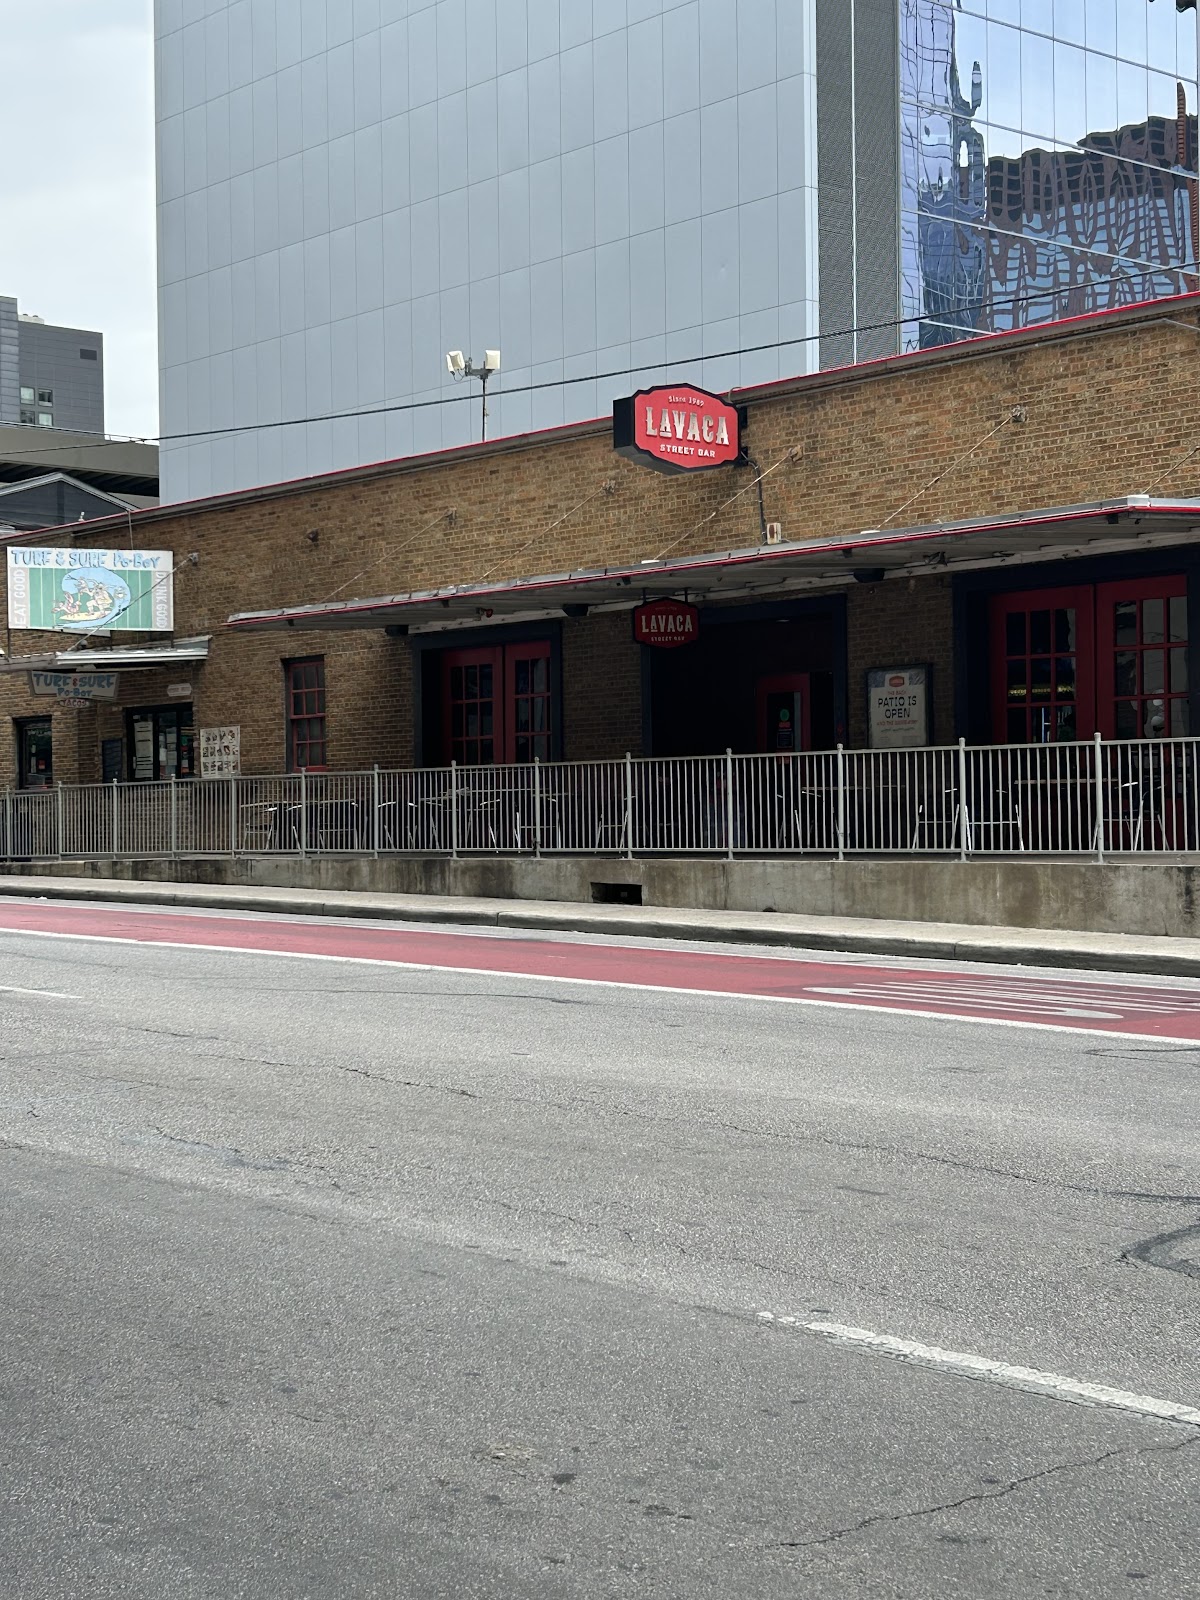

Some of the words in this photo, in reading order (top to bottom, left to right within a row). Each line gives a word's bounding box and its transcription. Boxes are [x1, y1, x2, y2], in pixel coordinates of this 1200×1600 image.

[646, 407, 730, 445] LAVACA
[660, 444, 694, 455] STREET
[698, 448, 715, 458] BAR
[11, 550, 51, 565] TURF
[56, 551, 65, 567] &
[69, 551, 107, 567] SURF
[13, 569, 26, 598] GOOD
[156, 571, 168, 603] DRINK
[14, 601, 26, 625] EAT
[156, 603, 168, 628] GOOD
[641, 615, 693, 633] LAVACA
[33, 674, 71, 687] TURF
[79, 675, 115, 688] SURF
[63, 699, 86, 707] TACOS
[878, 696, 905, 708] PATIO
[908, 695, 917, 706] IS
[885, 708, 910, 718] OPEN
